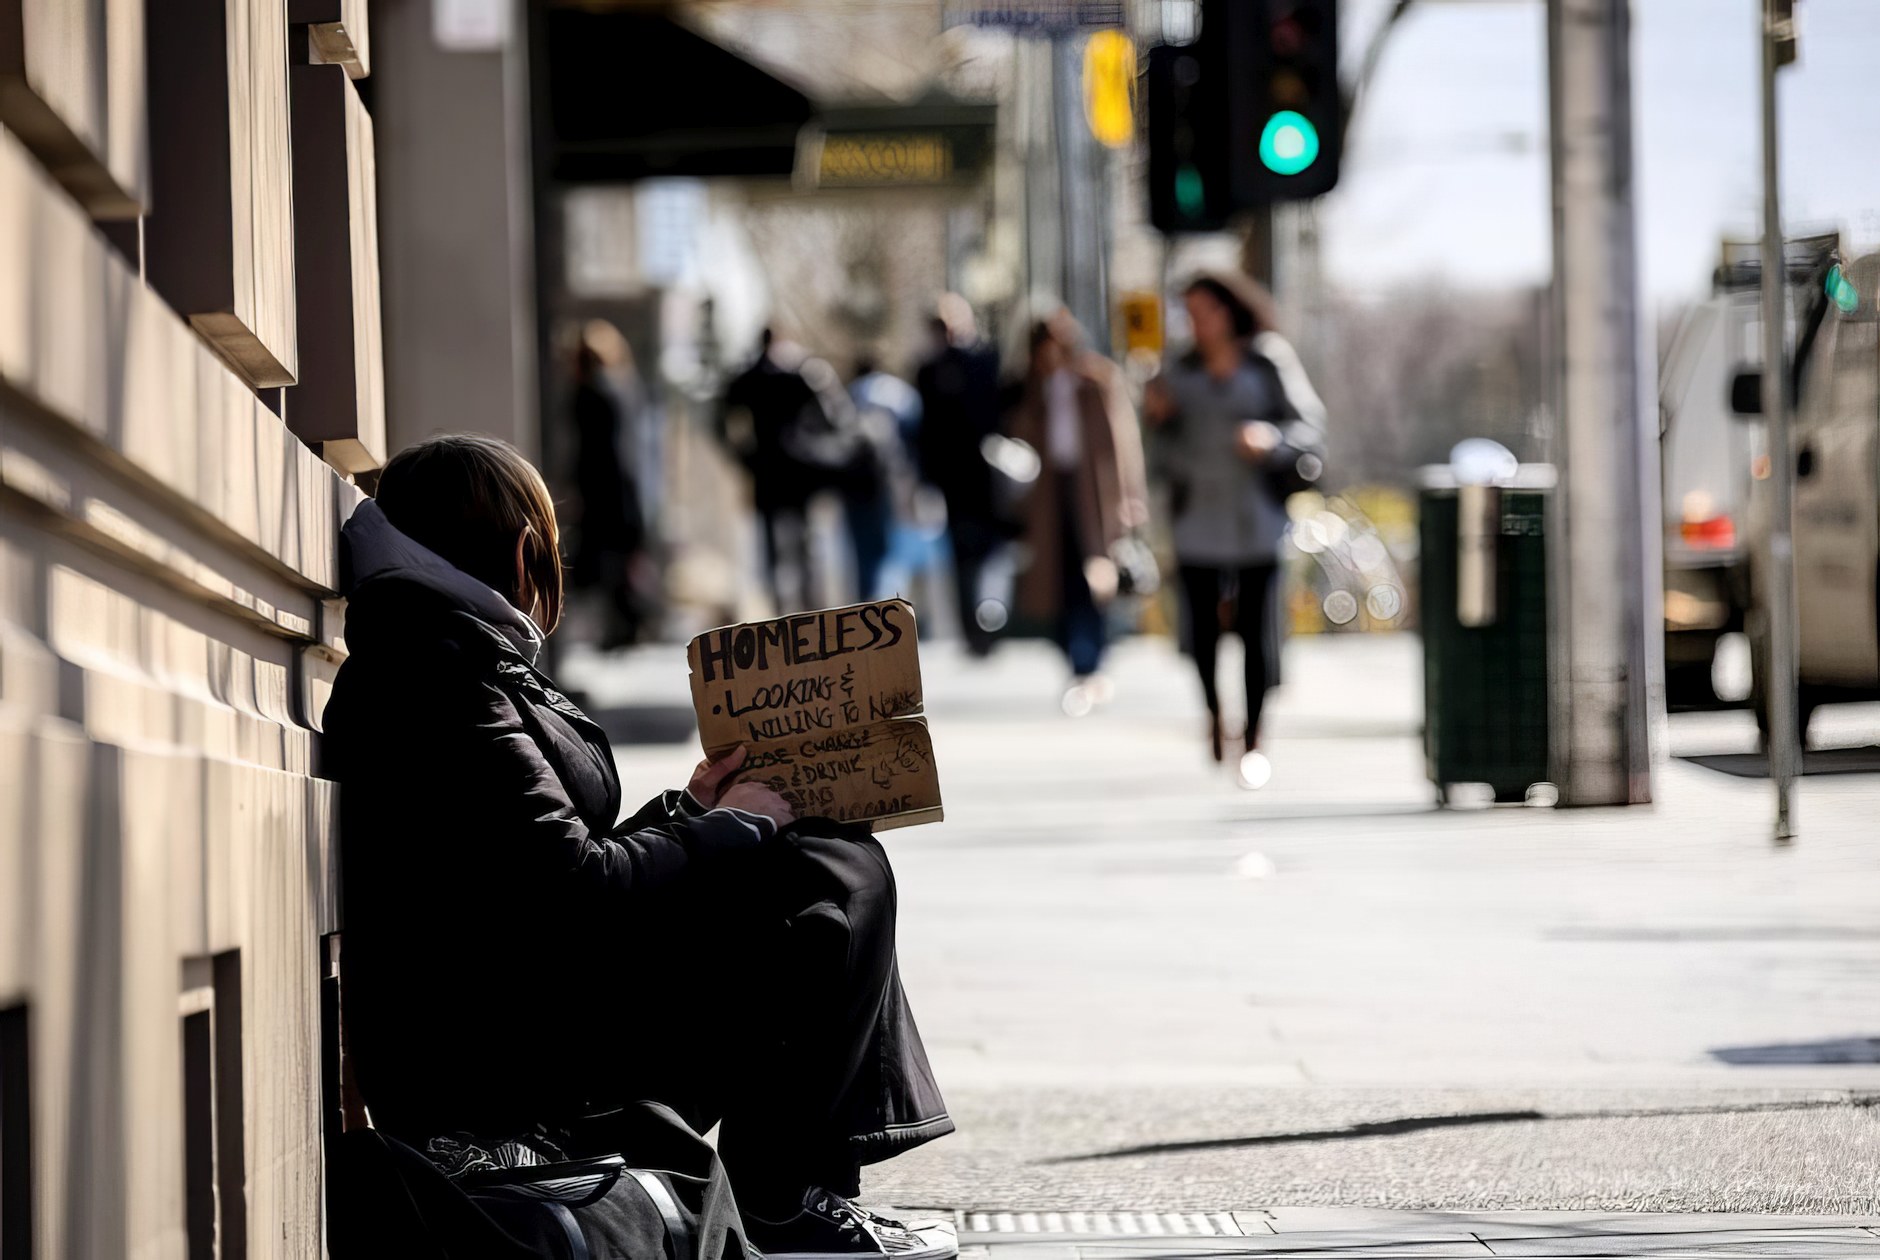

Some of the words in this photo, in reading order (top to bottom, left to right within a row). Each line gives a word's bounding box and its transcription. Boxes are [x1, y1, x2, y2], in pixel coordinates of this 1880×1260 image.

[699, 604, 903, 682] HOMELESS
[725, 673, 837, 718] LOOKING
[839, 699, 859, 725] TO
[741, 748, 795, 769] OOSE
[802, 754, 866, 784] DRINK
